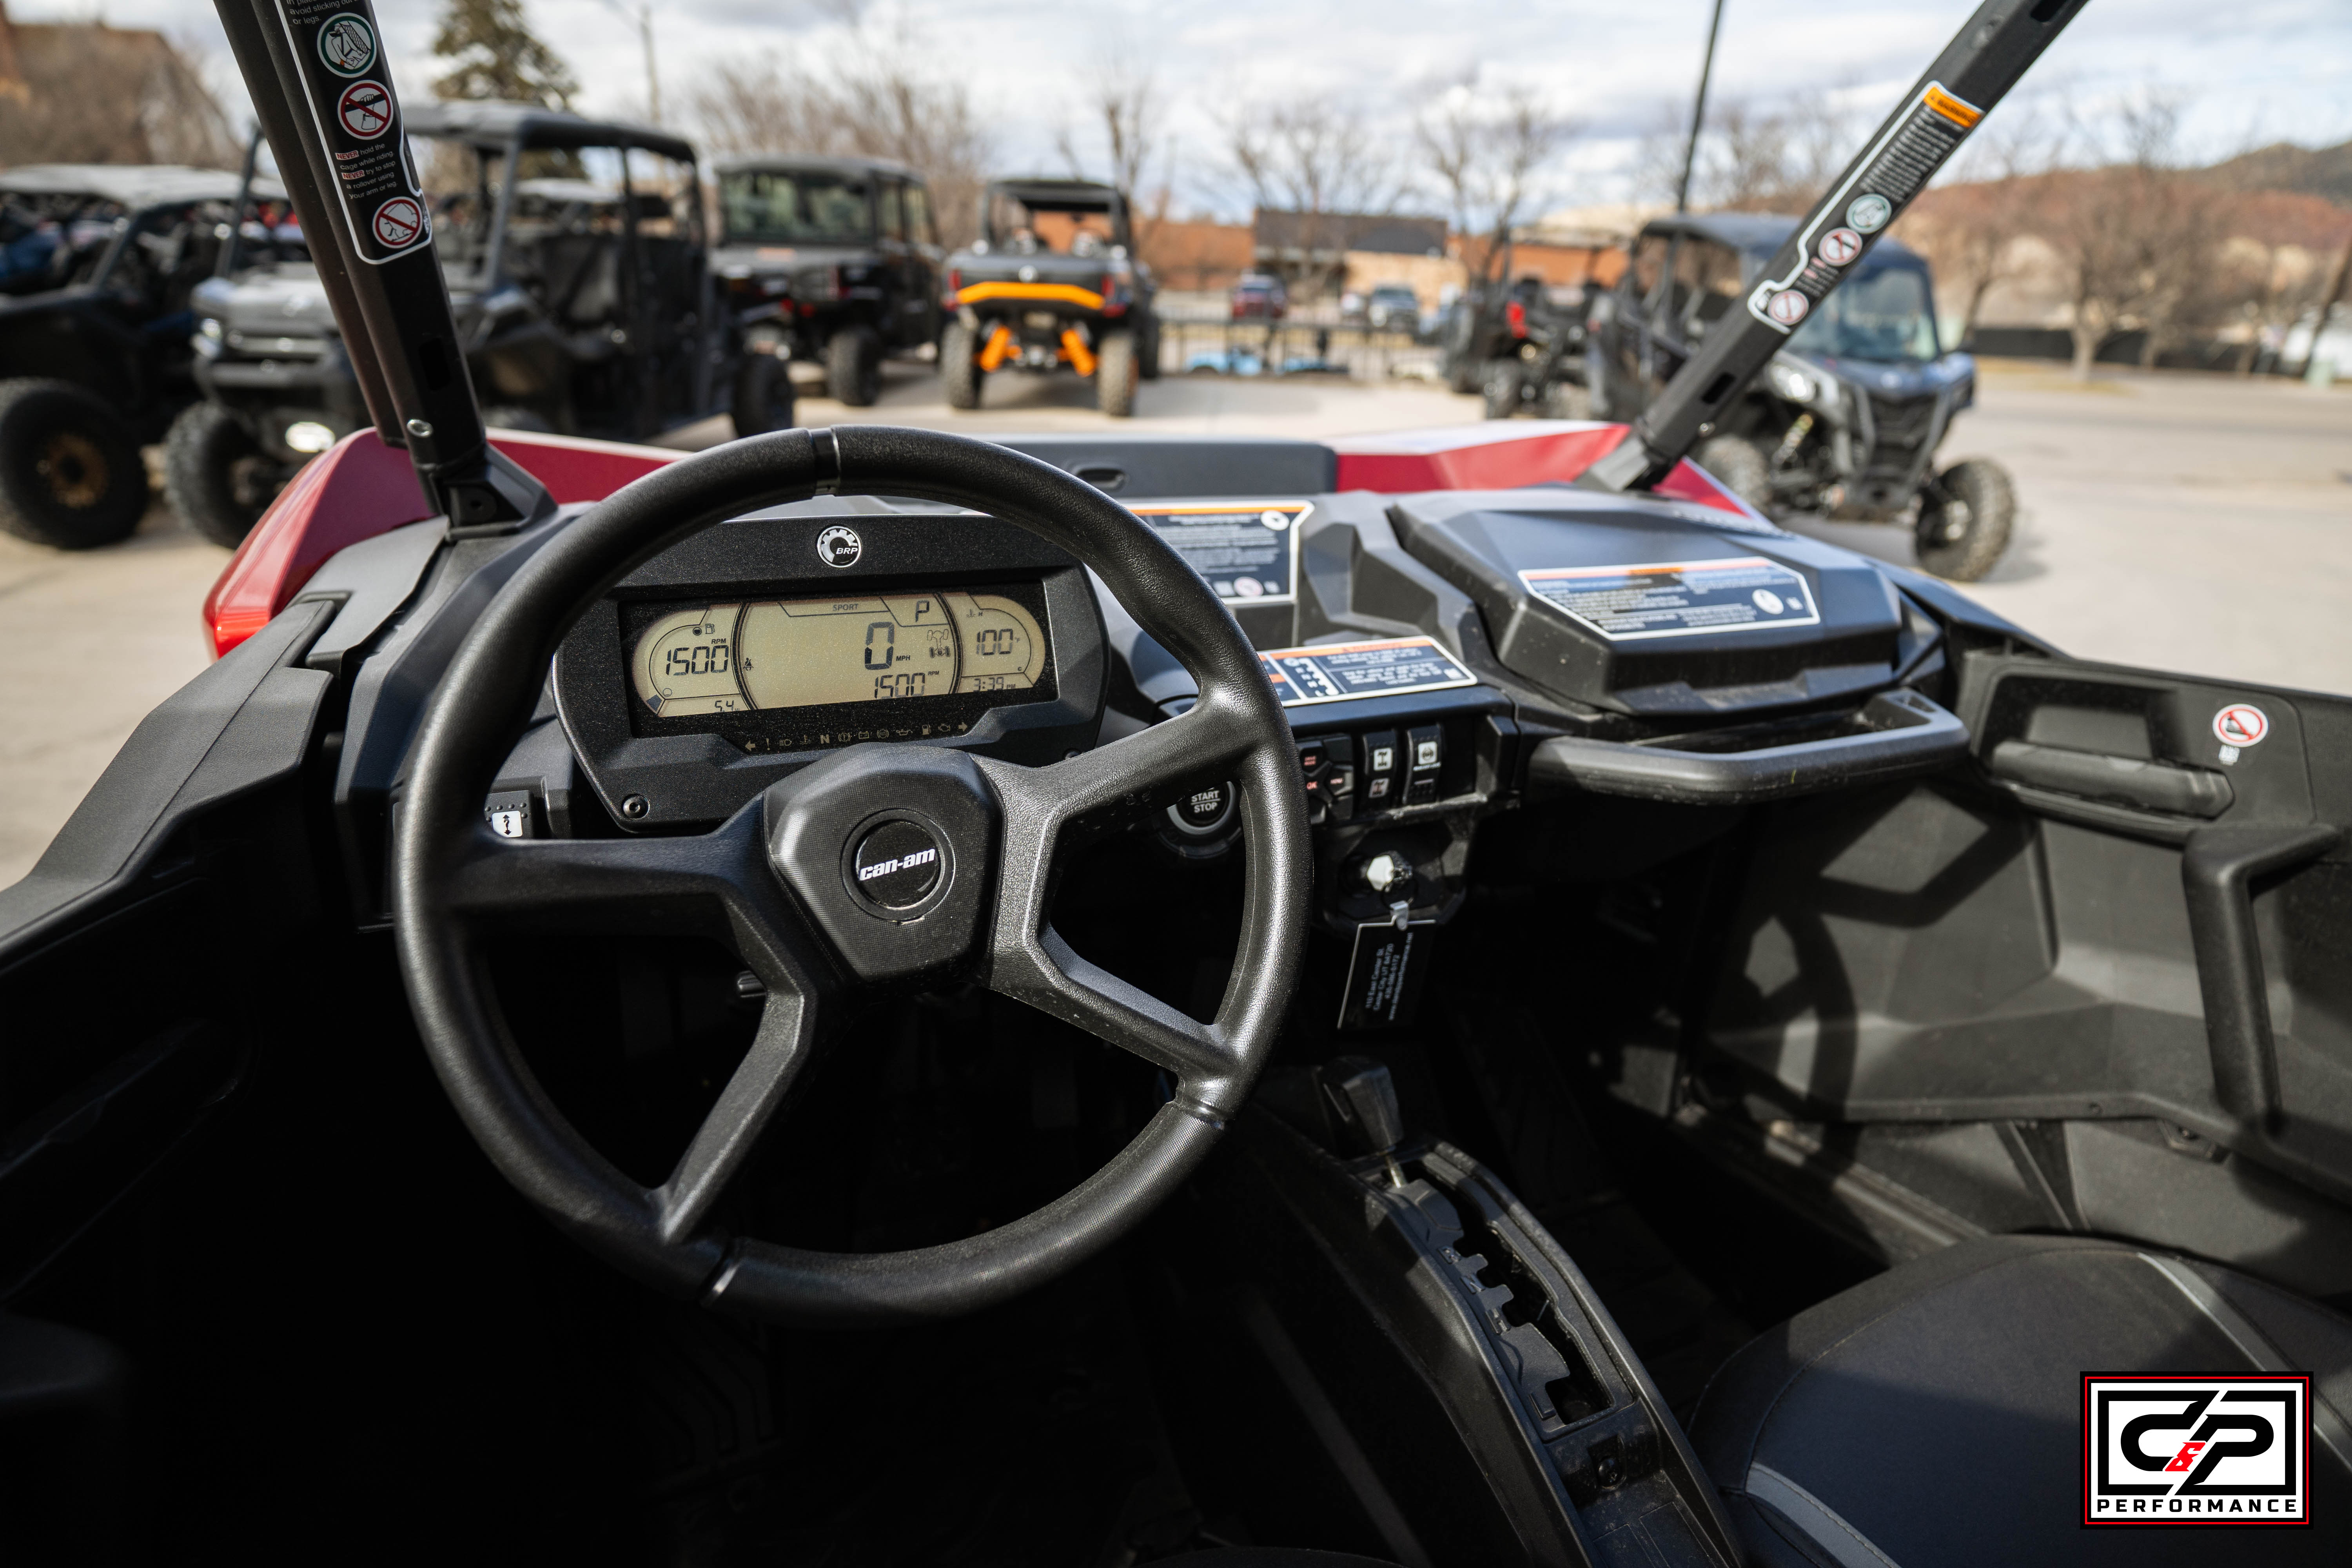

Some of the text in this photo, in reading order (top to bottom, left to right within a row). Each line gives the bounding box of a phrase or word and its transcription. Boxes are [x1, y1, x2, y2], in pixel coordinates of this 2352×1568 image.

[290, 5, 311, 15] avoid
[313, 1, 340, 12] sticking
[336, 151, 358, 160] NEVER
[360, 147, 374, 156] hold
[359, 157, 375, 167] while
[343, 170, 365, 179] NEVER
[383, 161, 396, 169] stop
[353, 178, 376, 189] rollover
[378, 172, 394, 181] using
[915, 600, 929, 622] P
[865, 621, 895, 670] 0
[976, 629, 1014, 656] 100
[666, 645, 729, 676] 1500
[875, 672, 926, 699] 1500
[973, 677, 1004, 692] 3:39
[820, 734, 830, 744] N
[1307, 781, 1318, 790] OK
[1191, 790, 1220, 802] START
[1194, 802, 1218, 813] STOP
[859, 848, 935, 881] can-am
[1459, 1274, 1486, 1294] N
[1486, 1307, 1512, 1335] H
[1529, 1392, 1557, 1420] L
